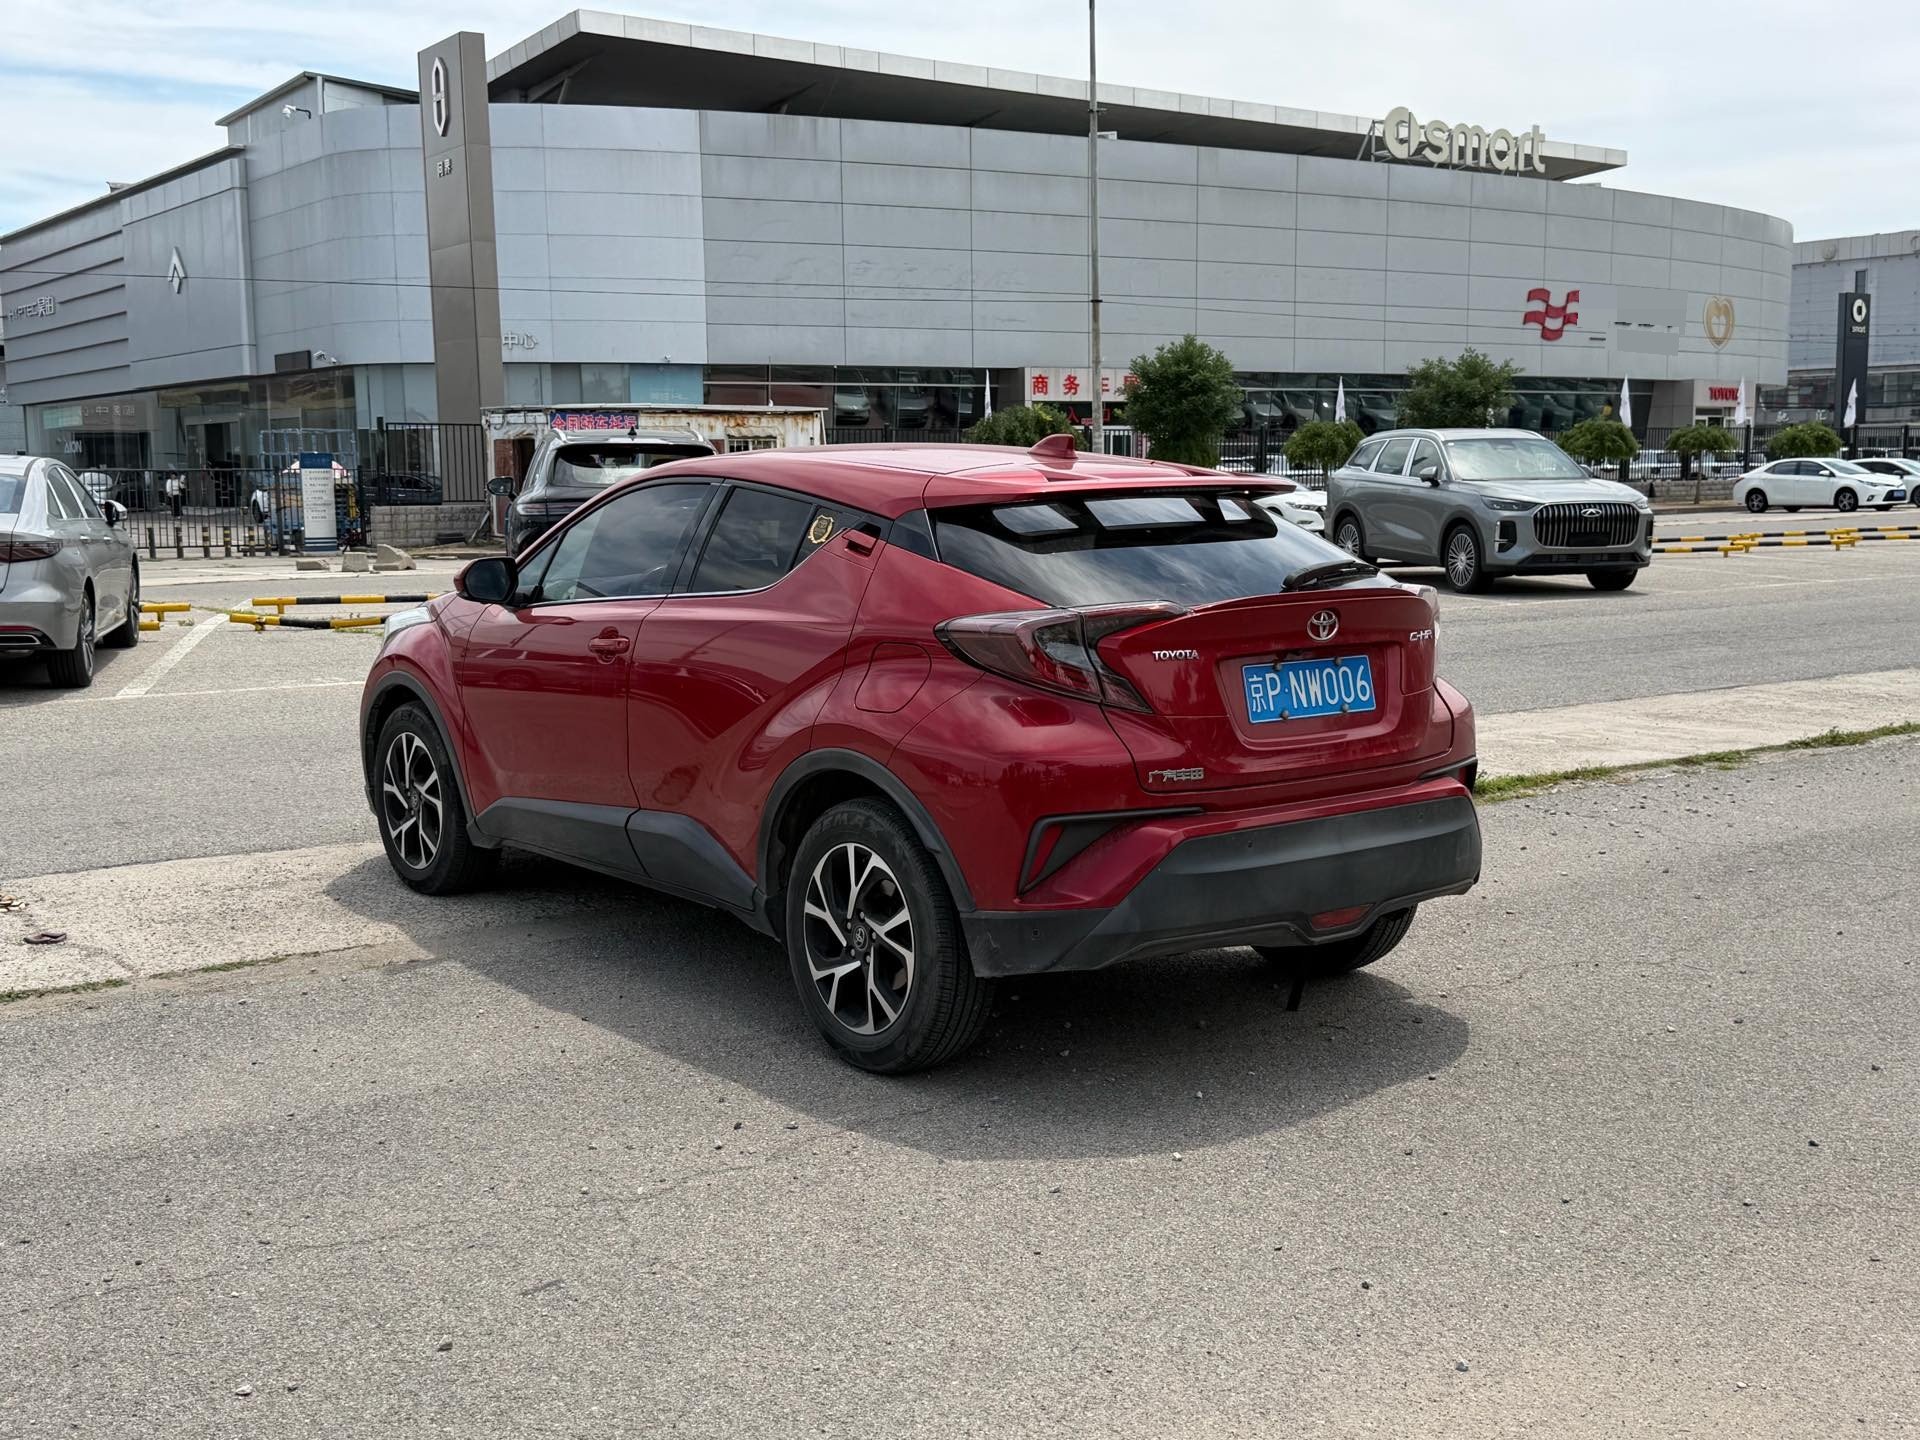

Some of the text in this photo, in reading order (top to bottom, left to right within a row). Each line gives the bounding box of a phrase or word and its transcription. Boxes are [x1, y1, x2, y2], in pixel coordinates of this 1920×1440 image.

[1422, 120, 1545, 173] smart
[1852, 325, 1866, 334] smart
[503, 331, 537, 350] 中心
[1410, 630, 1432, 641] C-HR
[1152, 649, 1200, 661] TOYOTA
